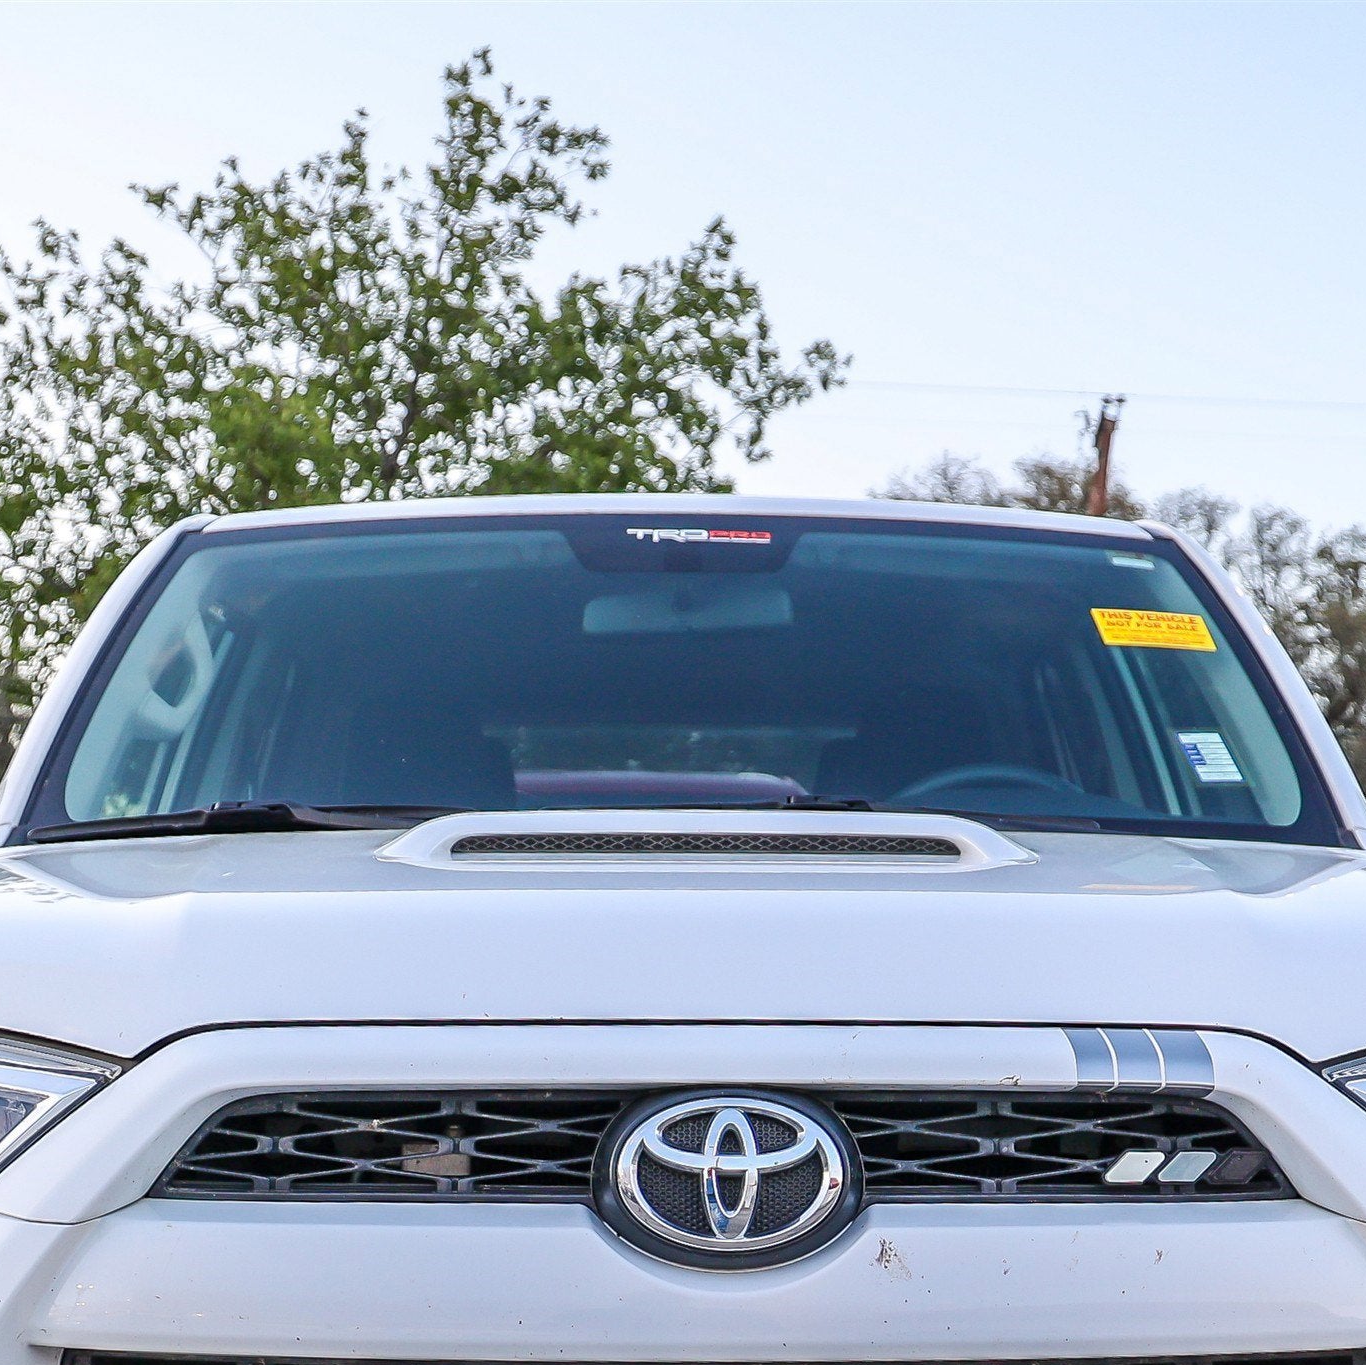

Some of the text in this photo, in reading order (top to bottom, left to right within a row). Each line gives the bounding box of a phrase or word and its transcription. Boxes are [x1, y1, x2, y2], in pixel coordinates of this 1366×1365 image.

[626, 528, 709, 543] TRD
[1099, 610, 1198, 624] THIS VEHICLE
[1136, 621, 1162, 629] FOR
[1167, 623, 1198, 631] SALE
